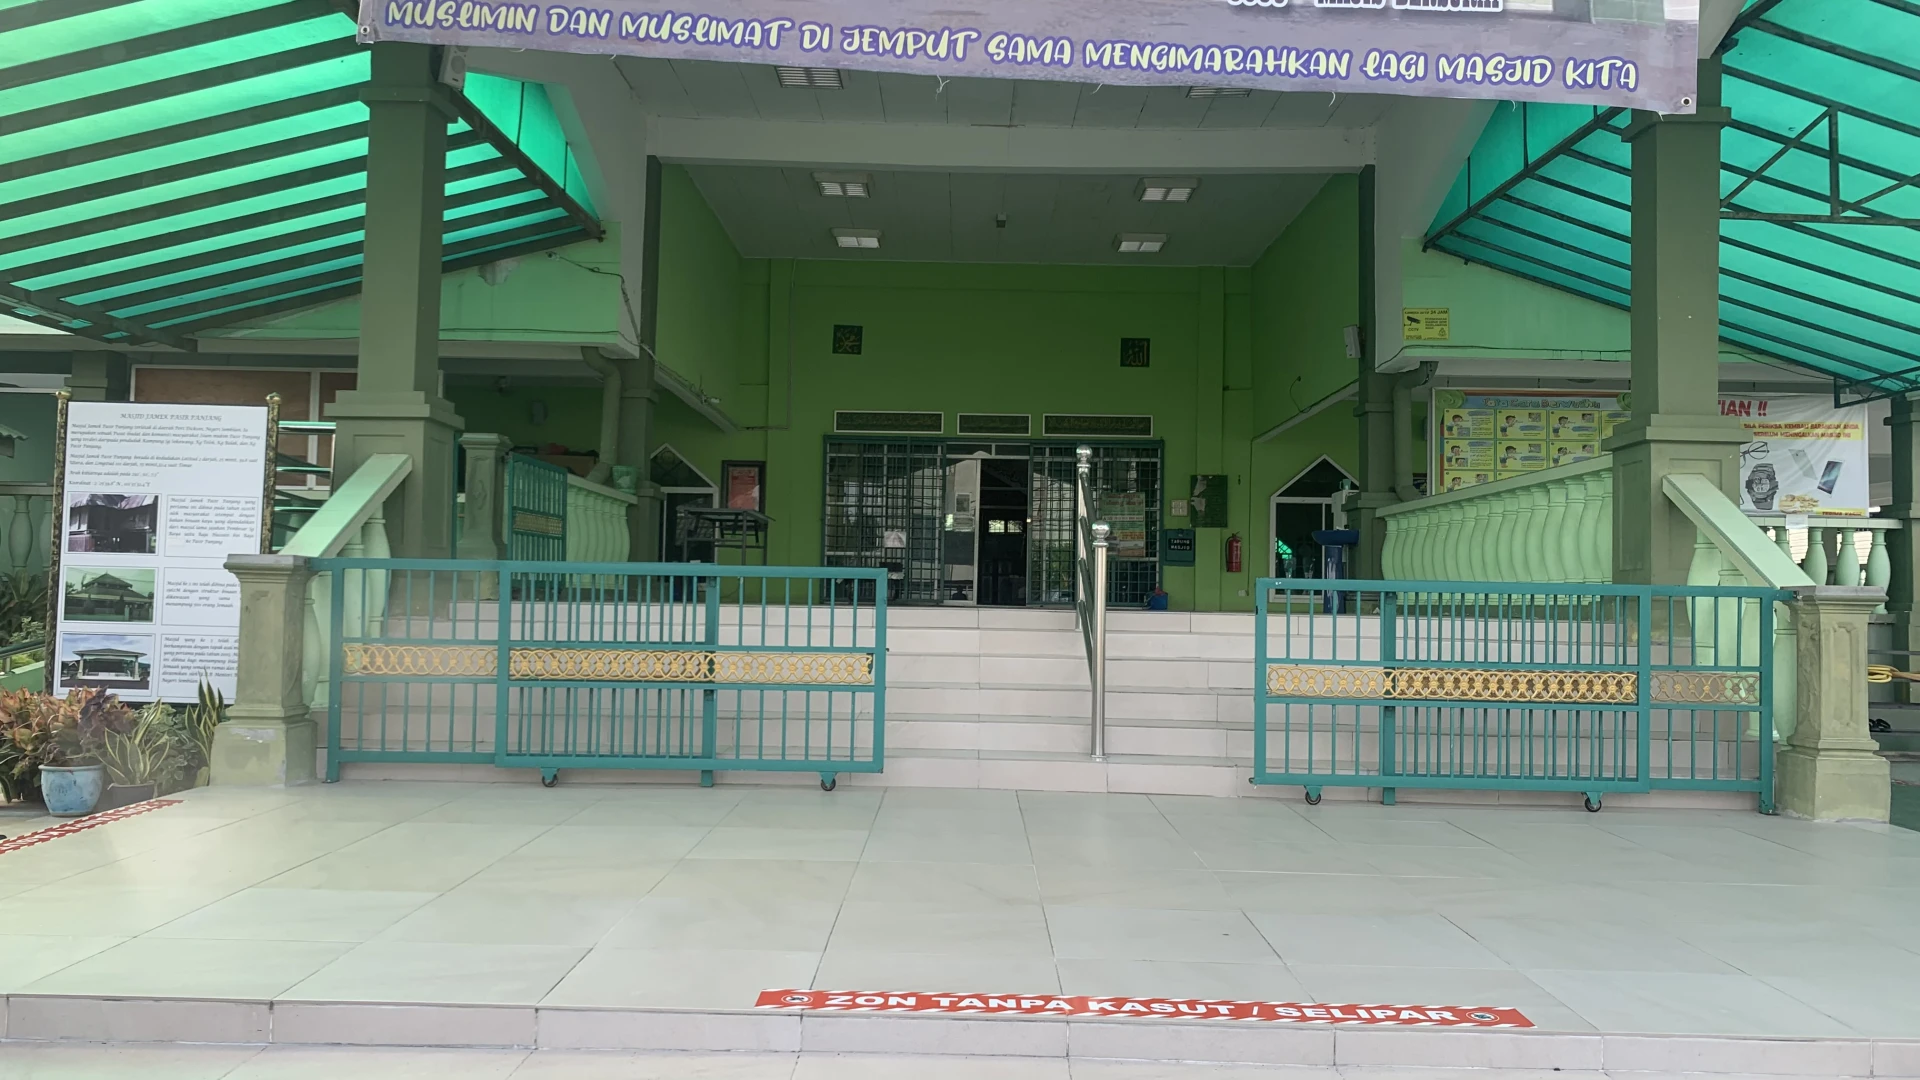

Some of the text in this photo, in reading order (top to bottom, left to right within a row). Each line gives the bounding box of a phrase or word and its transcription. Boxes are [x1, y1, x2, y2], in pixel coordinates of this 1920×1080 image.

[387, 1, 1637, 88] MUSLIMIN DAN MUSLIMAT DI JEMPUT SAMA MENGIMARAHKAN LAGI MASJID KITA
[825, 995, 1461, 1021] ZON TANPA KASUT / SELIPAR
